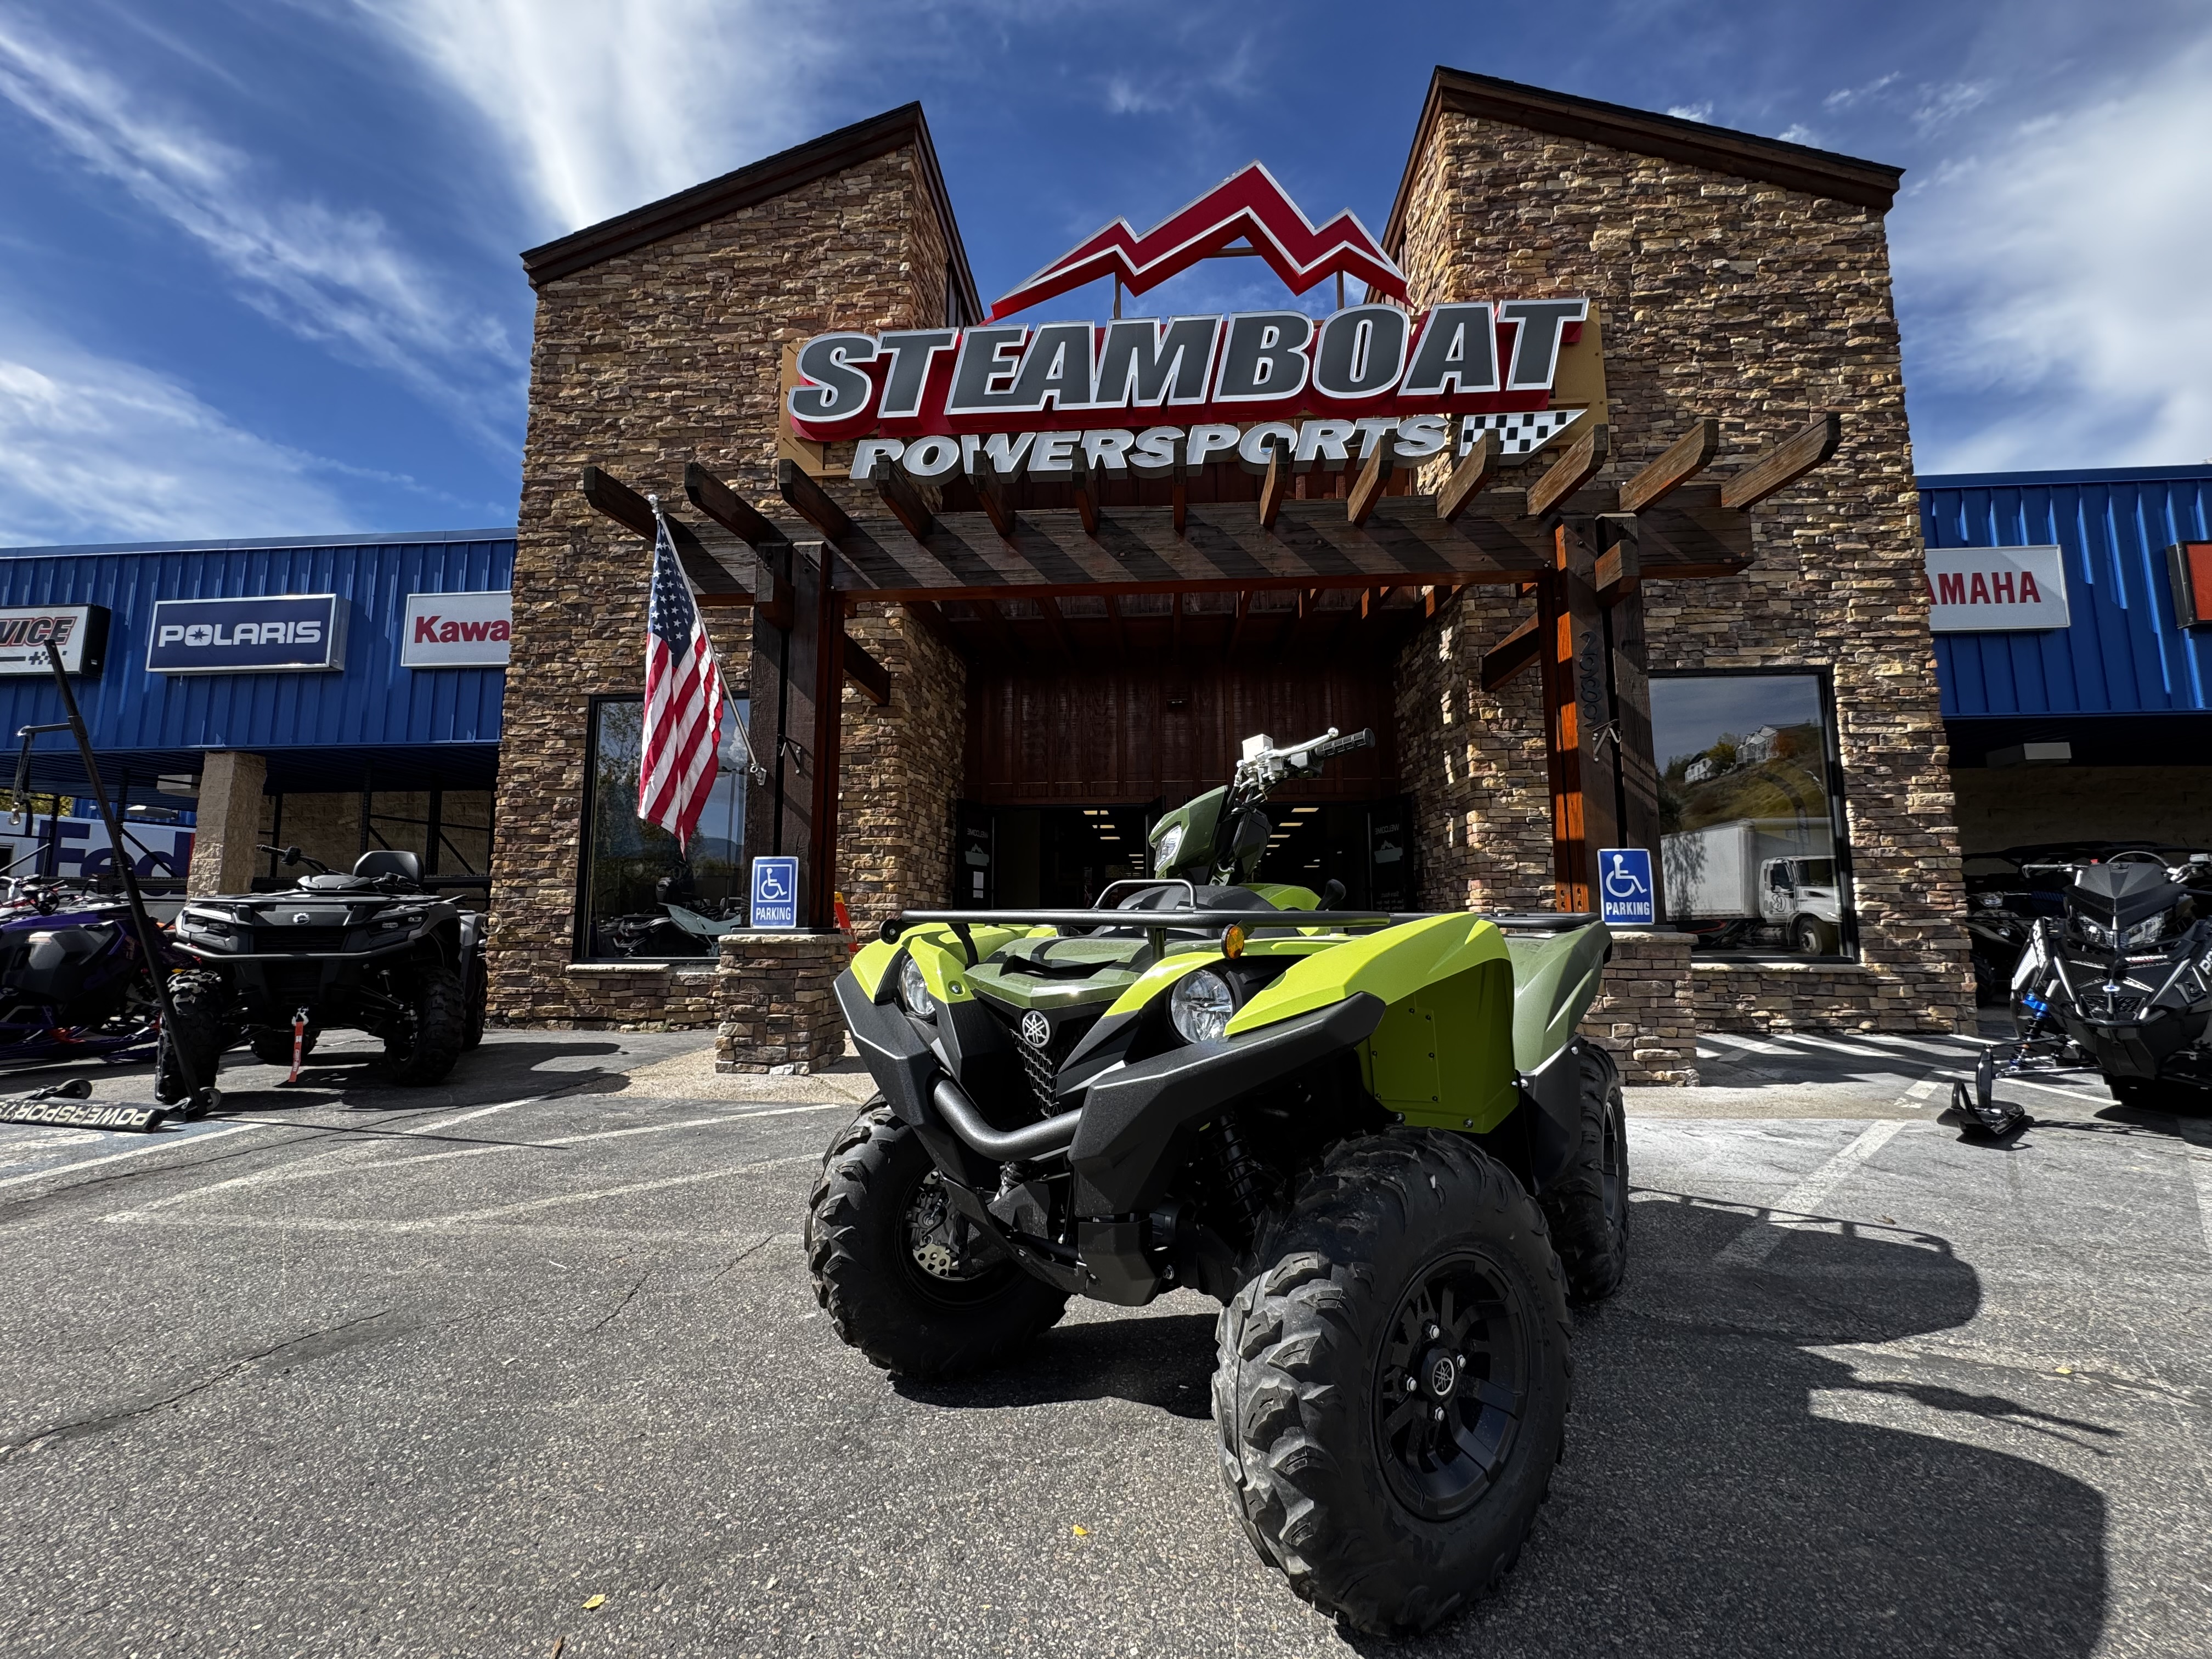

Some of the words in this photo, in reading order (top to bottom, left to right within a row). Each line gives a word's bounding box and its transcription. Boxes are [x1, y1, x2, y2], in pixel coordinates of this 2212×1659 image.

[787, 297, 1590, 424] STEAMBOAT
[849, 414, 1449, 483] POWERSPORTS
[158, 620, 321, 647] POLARIS
[414, 616, 510, 644] Kawa
[1579, 630, 1602, 727] 2989
[755, 907, 791, 921] PARKING
[1606, 901, 1650, 916] PARKING
